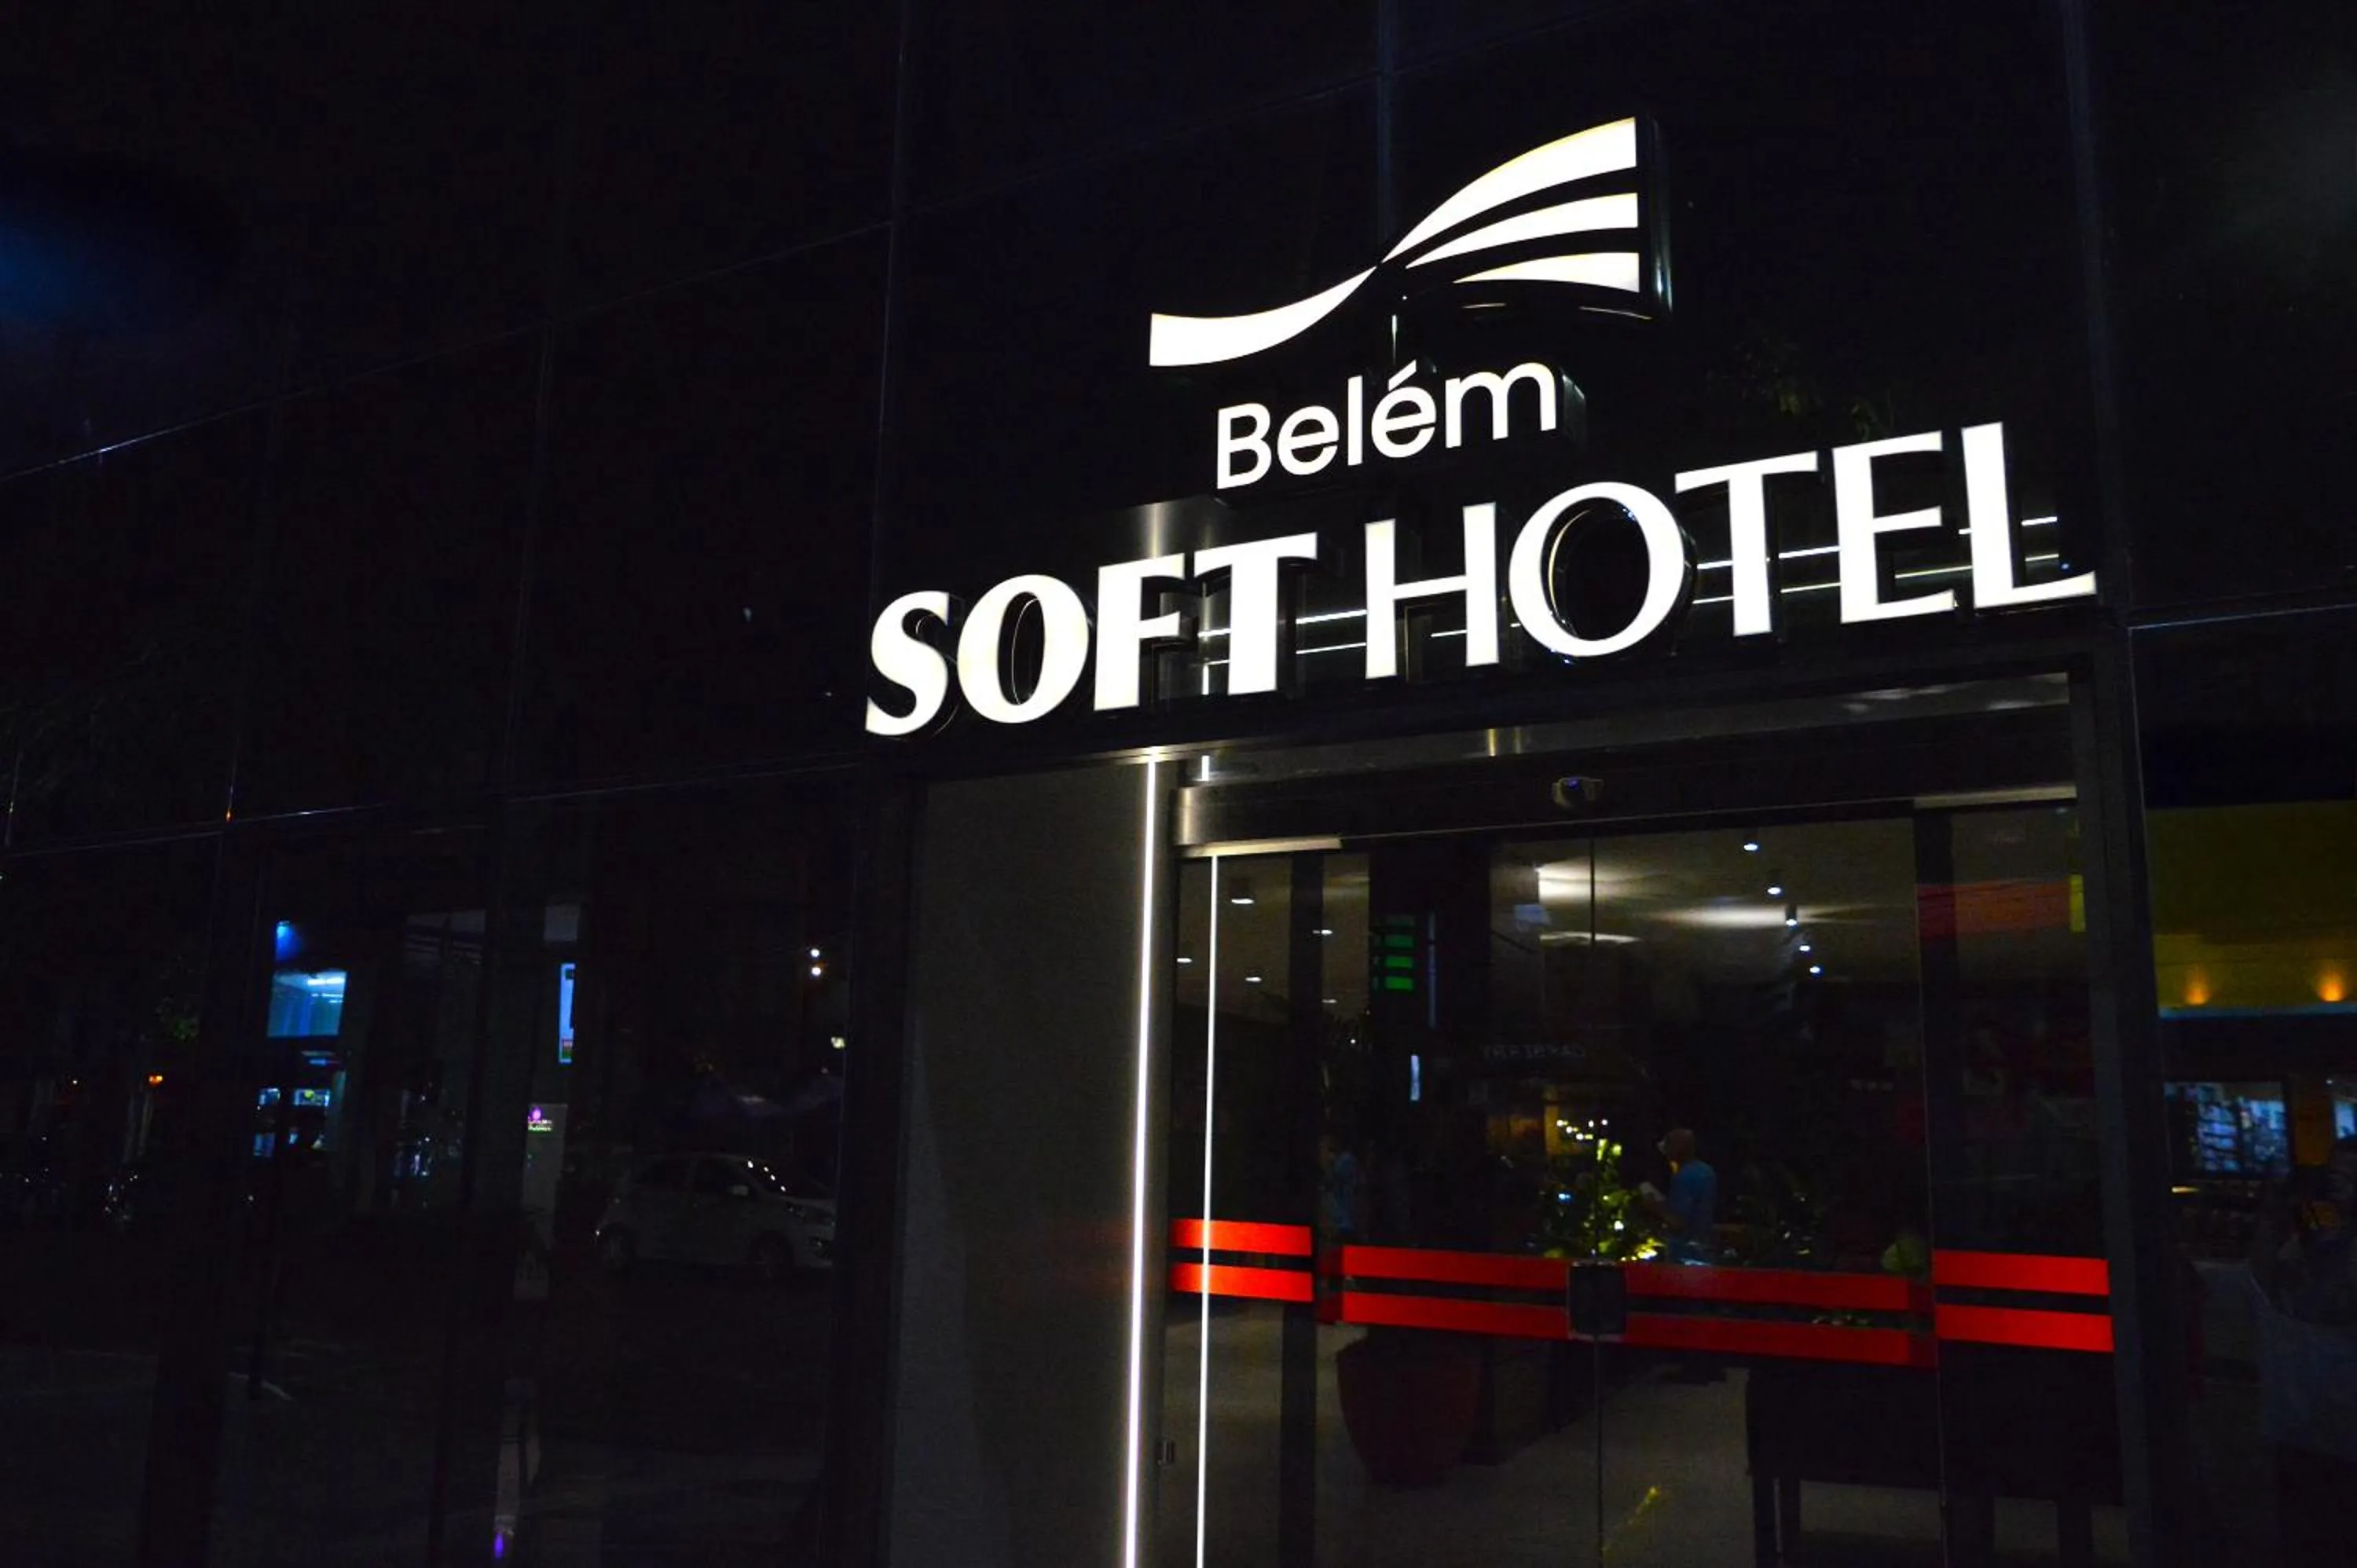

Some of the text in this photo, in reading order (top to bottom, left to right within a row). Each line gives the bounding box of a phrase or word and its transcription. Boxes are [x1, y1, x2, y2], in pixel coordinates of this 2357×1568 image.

[1216, 360, 1556, 490] Belém
[865, 422, 2096, 736] SOFT HOTEL
